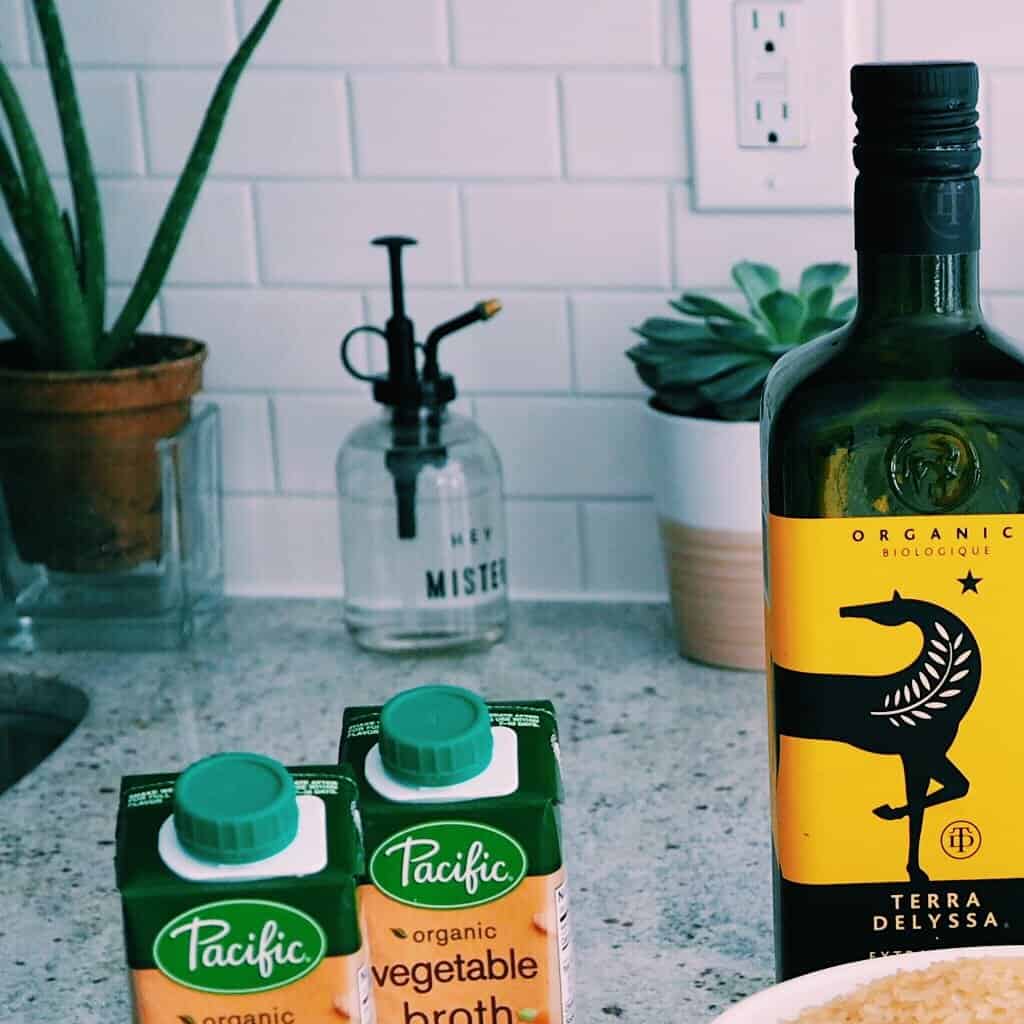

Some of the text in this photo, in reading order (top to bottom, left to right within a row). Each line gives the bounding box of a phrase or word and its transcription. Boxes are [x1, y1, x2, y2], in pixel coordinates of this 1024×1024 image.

[852, 527, 1013, 542] ORGANIC
[882, 546, 991, 558] BIOLOGIQUE
[385, 836, 509, 895] Pacific
[890, 891, 981, 910] TERRA
[873, 911, 999, 931] DELYSSA
[413, 922, 497, 946] organic
[169, 915, 305, 978] Pacific
[371, 948, 538, 993] vegetable
